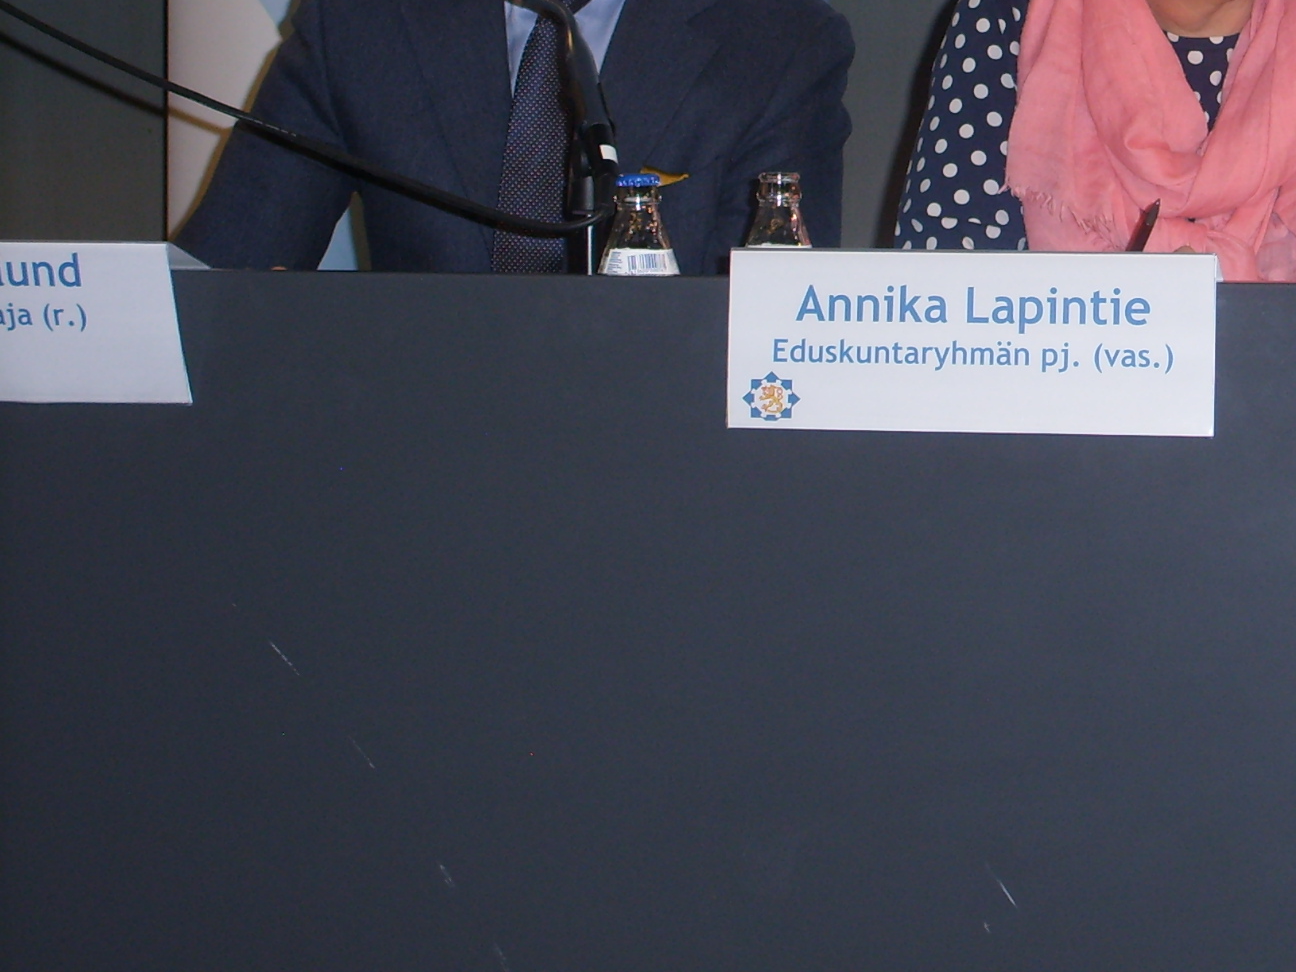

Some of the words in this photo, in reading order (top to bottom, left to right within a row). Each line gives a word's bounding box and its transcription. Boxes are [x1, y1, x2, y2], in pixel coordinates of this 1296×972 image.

[0, 252, 82, 288] und
[43, 303, 87, 332] (r.)
[795, 284, 948, 323] Annika
[966, 286, 1151, 334] Lapintie
[772, 338, 1030, 371] Eduskuntaryhmän
[1041, 343, 1080, 374] pj.
[1094, 343, 1175, 374] (vas.)
